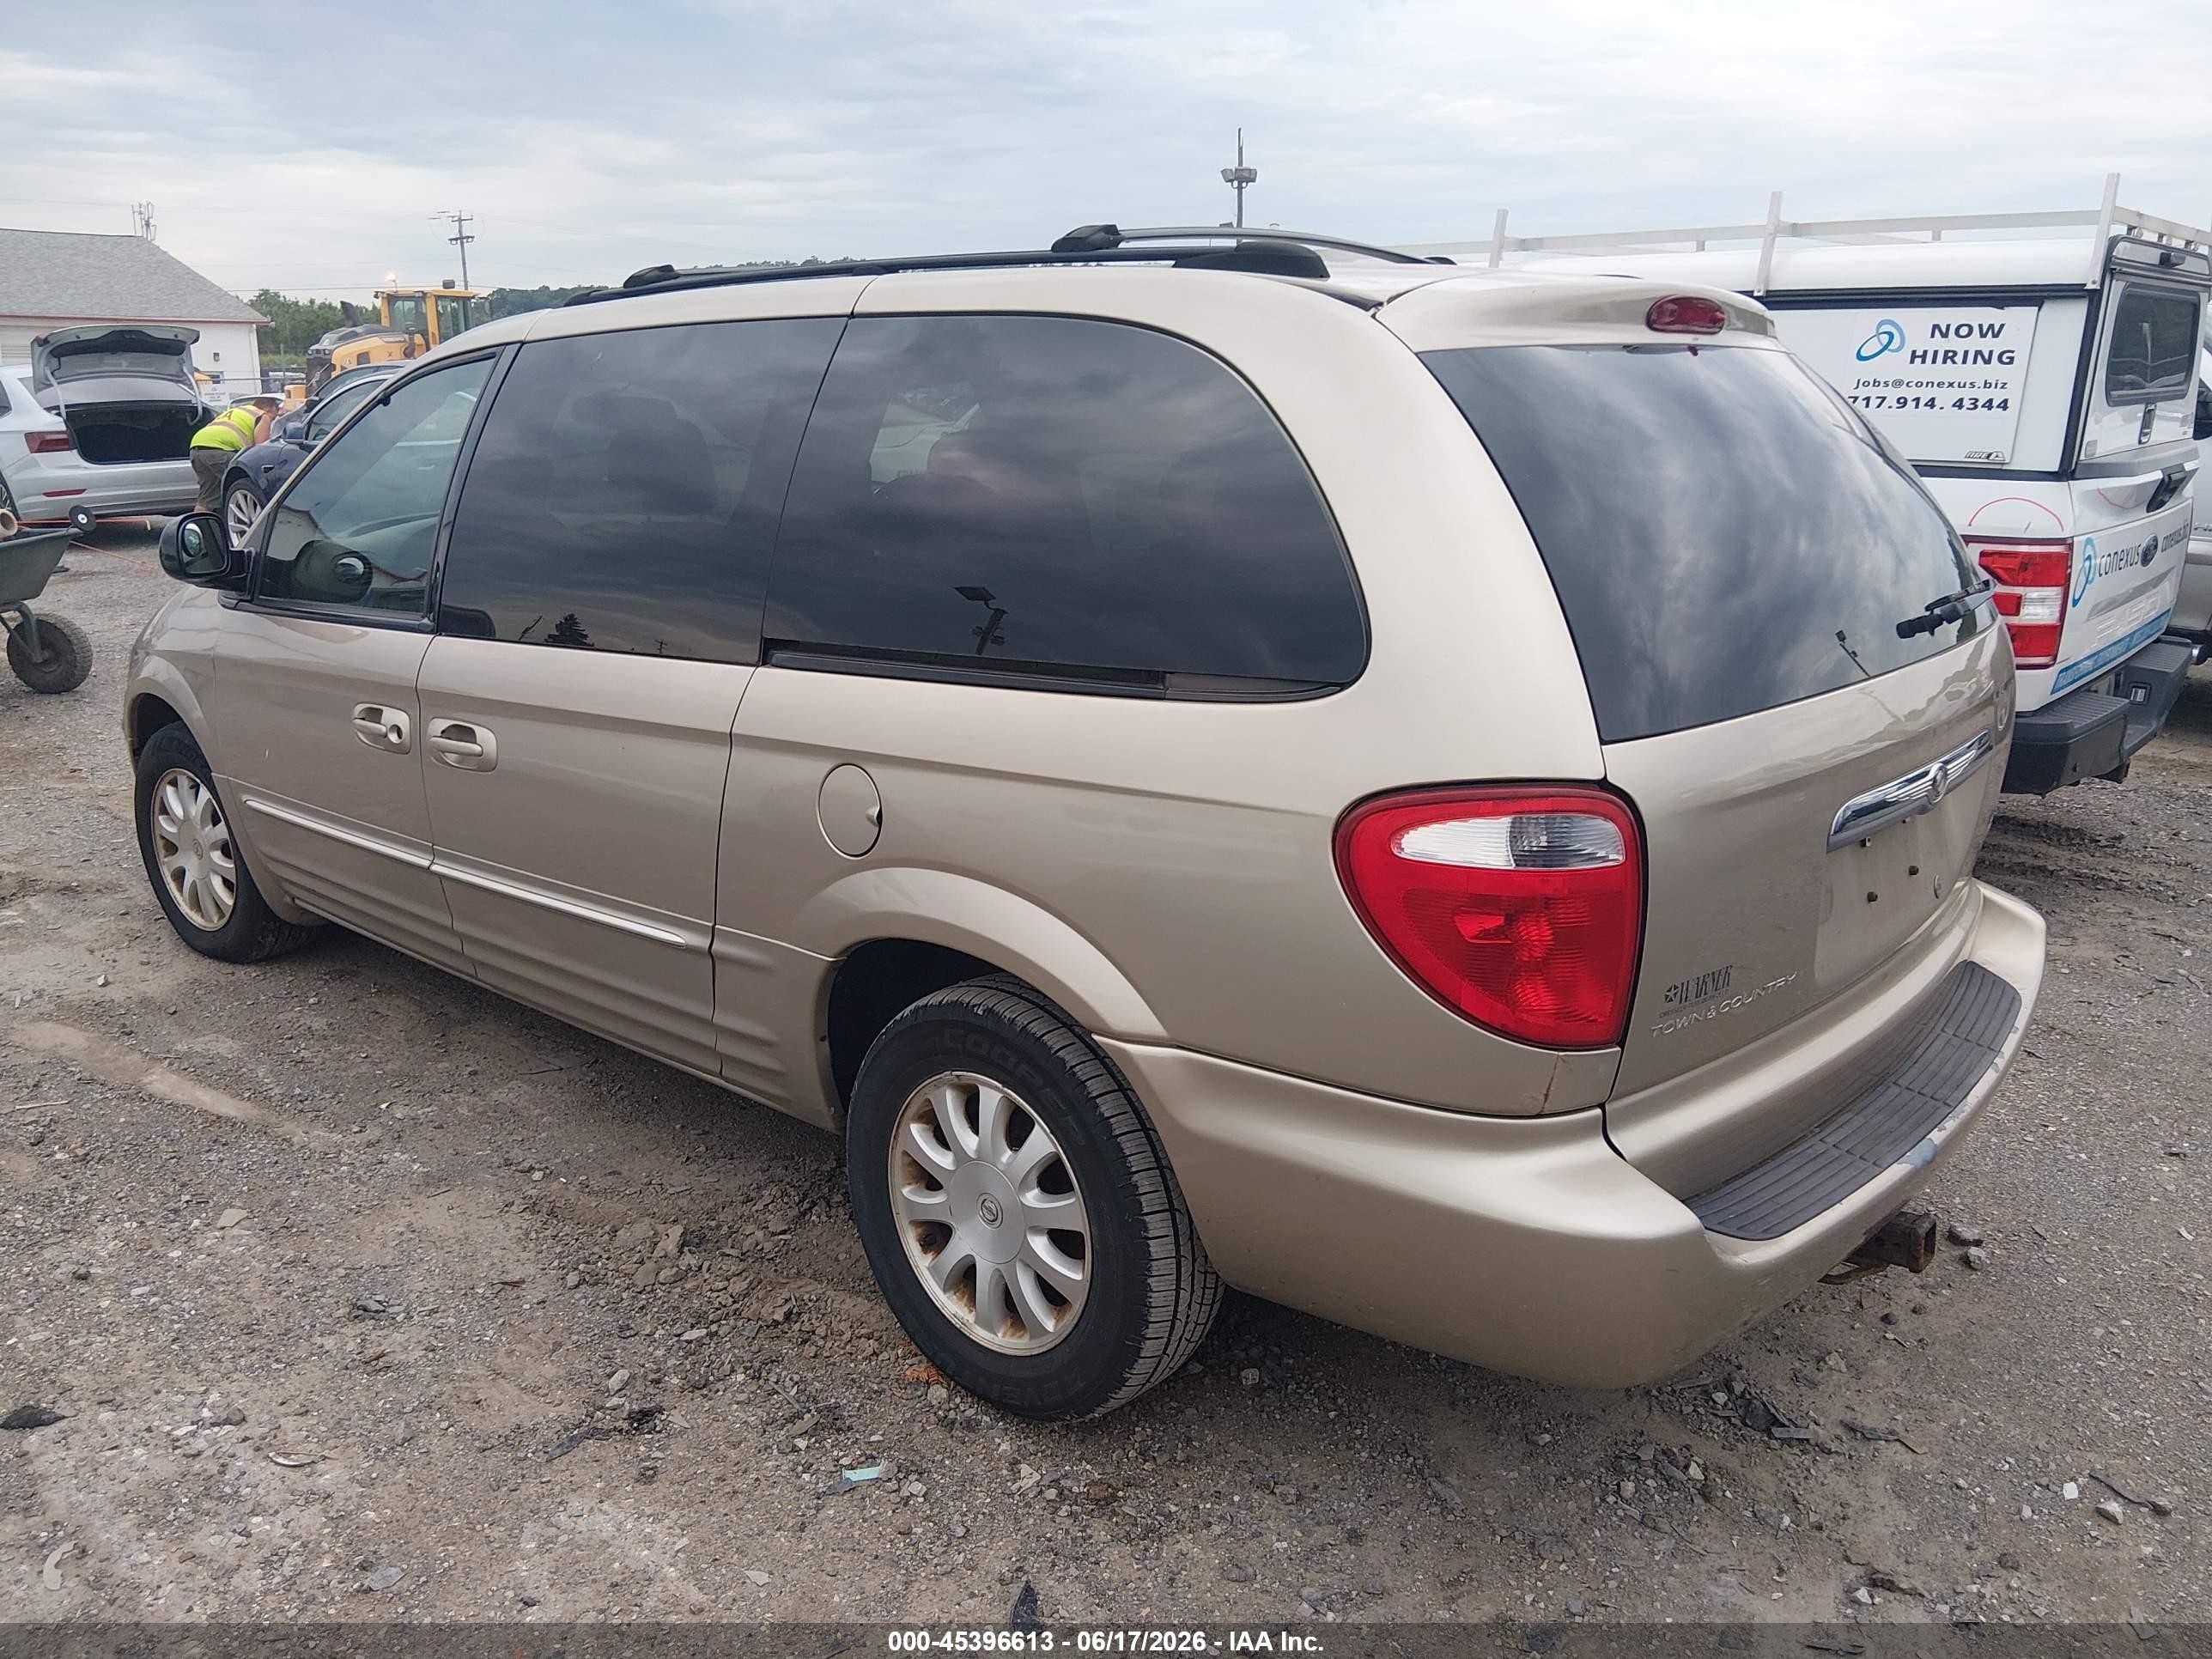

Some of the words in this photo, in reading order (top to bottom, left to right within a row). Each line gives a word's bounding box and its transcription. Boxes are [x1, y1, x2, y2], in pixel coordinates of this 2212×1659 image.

[1930, 323, 2006, 339] NOW
[1909, 349, 2015, 366] HIRING
[2098, 544, 2142, 578] conexus
[1650, 1010, 1705, 1037] TOWN
[1706, 1005, 1717, 1019] &
[1718, 971, 1798, 1013] COUNTRY
